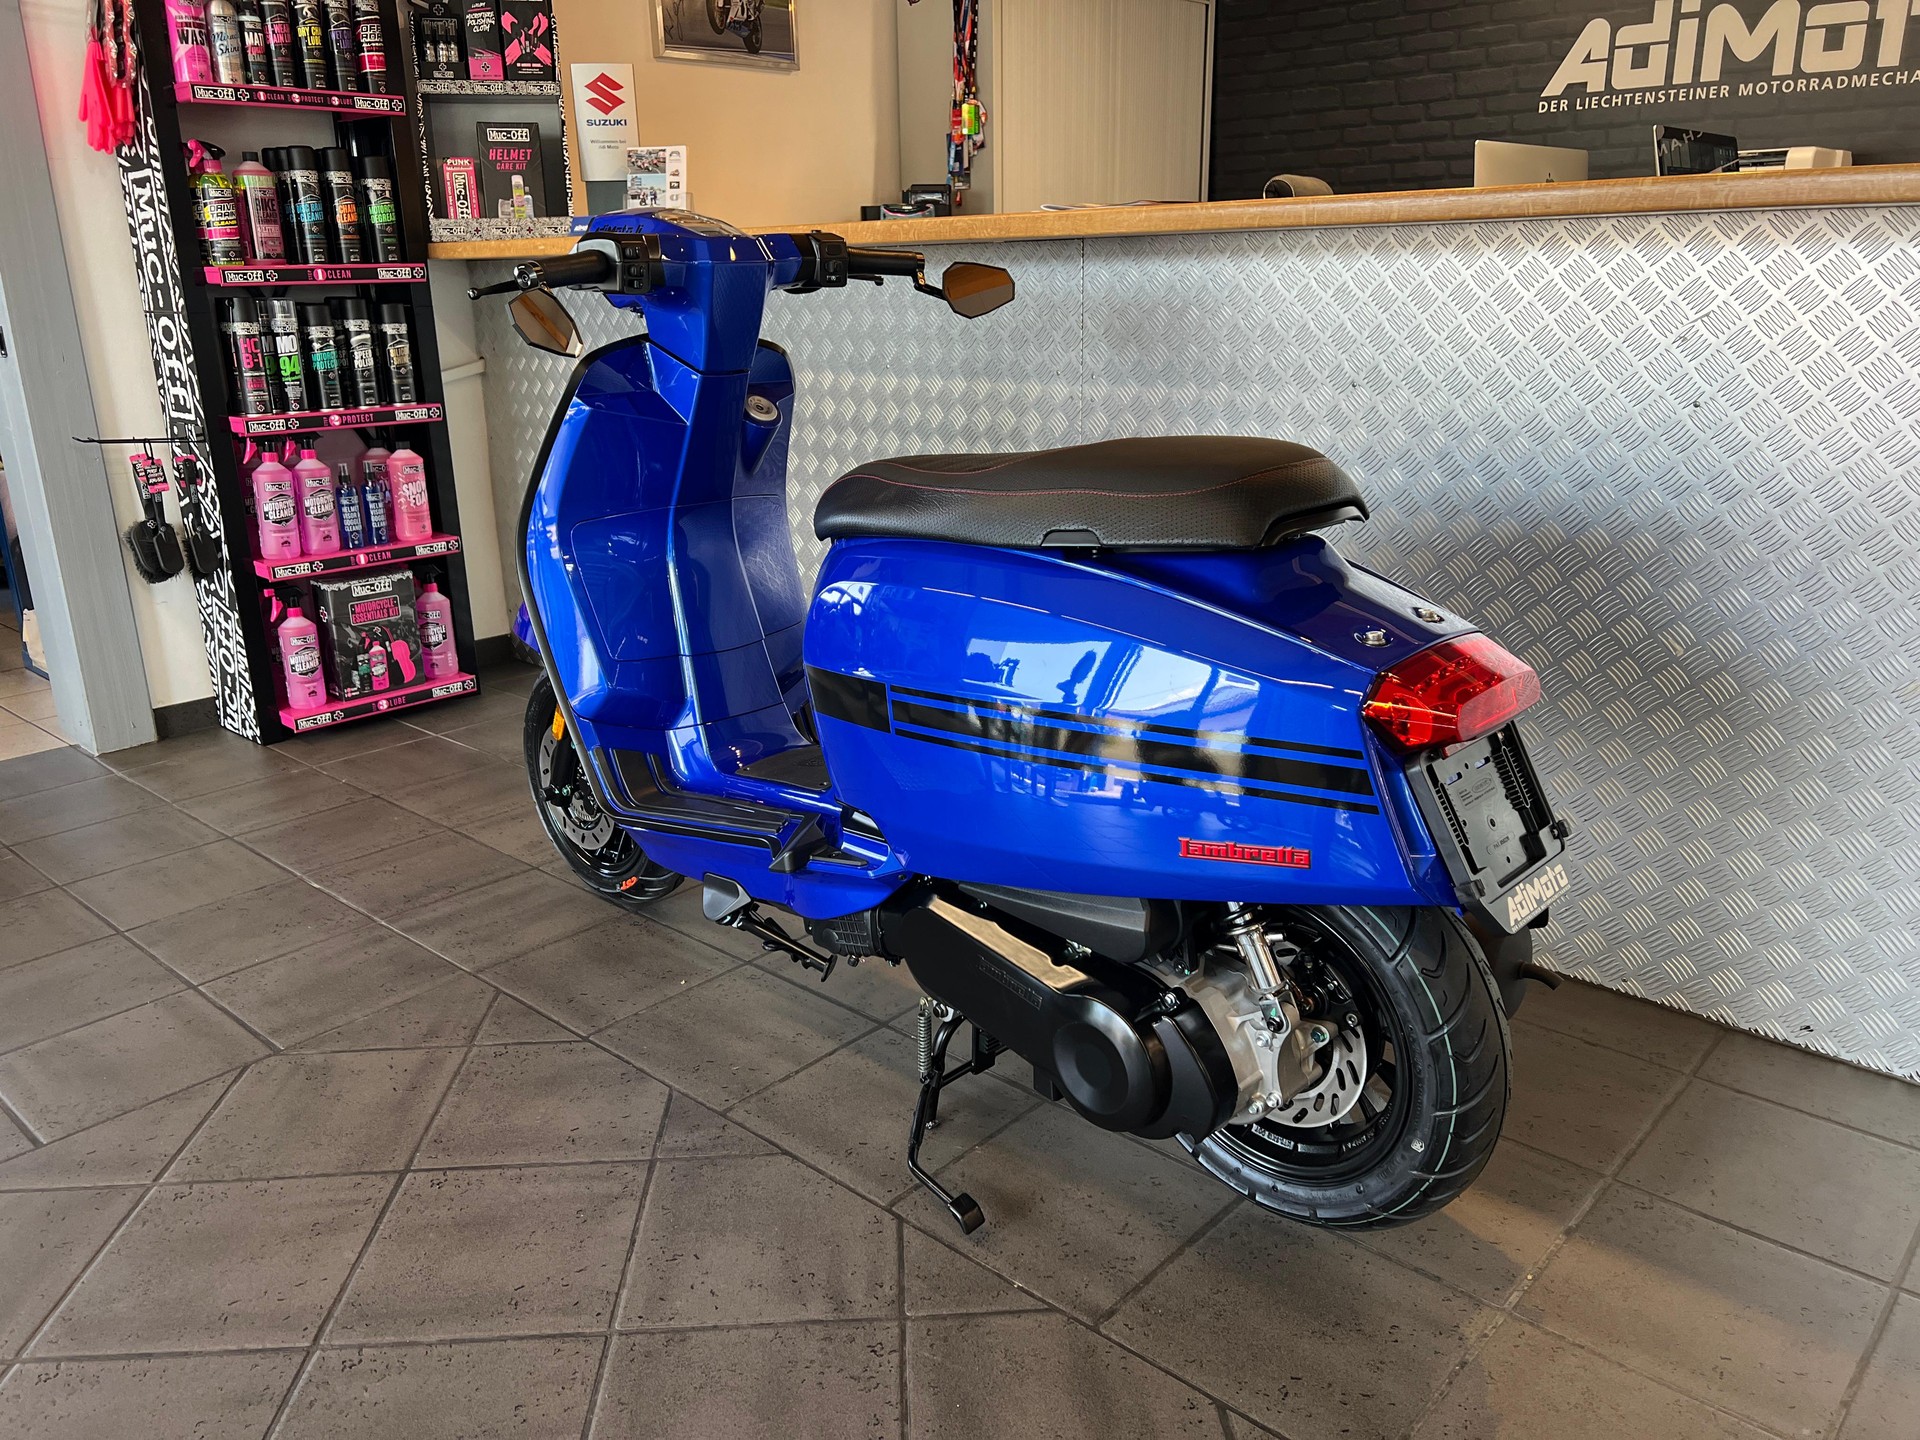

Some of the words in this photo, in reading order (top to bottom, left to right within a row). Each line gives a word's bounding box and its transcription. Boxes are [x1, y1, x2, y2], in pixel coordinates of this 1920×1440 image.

[177, 29, 206, 45] WAS
[1540, 0, 1920, 97] AdiMot
[197, 87, 234, 99] Muc-Off
[421, 83, 450, 92] Muc-Off
[475, 83, 504, 92] Muc-Off
[356, 98, 389, 109] Muc-Off
[1538, 97, 1568, 113] DER
[1575, 85, 1729, 110] LIECHTENSTEINER
[489, 130, 528, 140] Muc-Off
[489, 148, 532, 161] HELMET
[447, 158, 470, 166] PUNK
[455, 174, 470, 219] Muc-Off
[227, 271, 263, 281] Muc-Off
[327, 269, 351, 279] CLEAN
[379, 268, 410, 279] Muc-Off
[139, 184, 189, 410] Muc-Off
[279, 355, 301, 376] 94
[343, 414, 374, 424] PROTECT
[396, 409, 427, 420] Muc-Off
[250, 421, 284, 432] Muc-Off
[410, 491, 428, 506] FOA
[417, 543, 447, 555] Muc-Off
[369, 553, 391, 563] CLEAN
[276, 564, 310, 577] Muc-Off
[354, 581, 390, 594] Muc-Off
[355, 598, 394, 613] MOTORCYCLE
[352, 609, 388, 623] ESSENTIALS
[389, 606, 398, 617] KIT
[216, 610, 240, 731] uc-Off
[433, 683, 463, 697] Muc-Off
[390, 697, 407, 707] LUBE
[298, 714, 332, 729] Muc-Off
[1178, 837, 1311, 869] Lambretta
